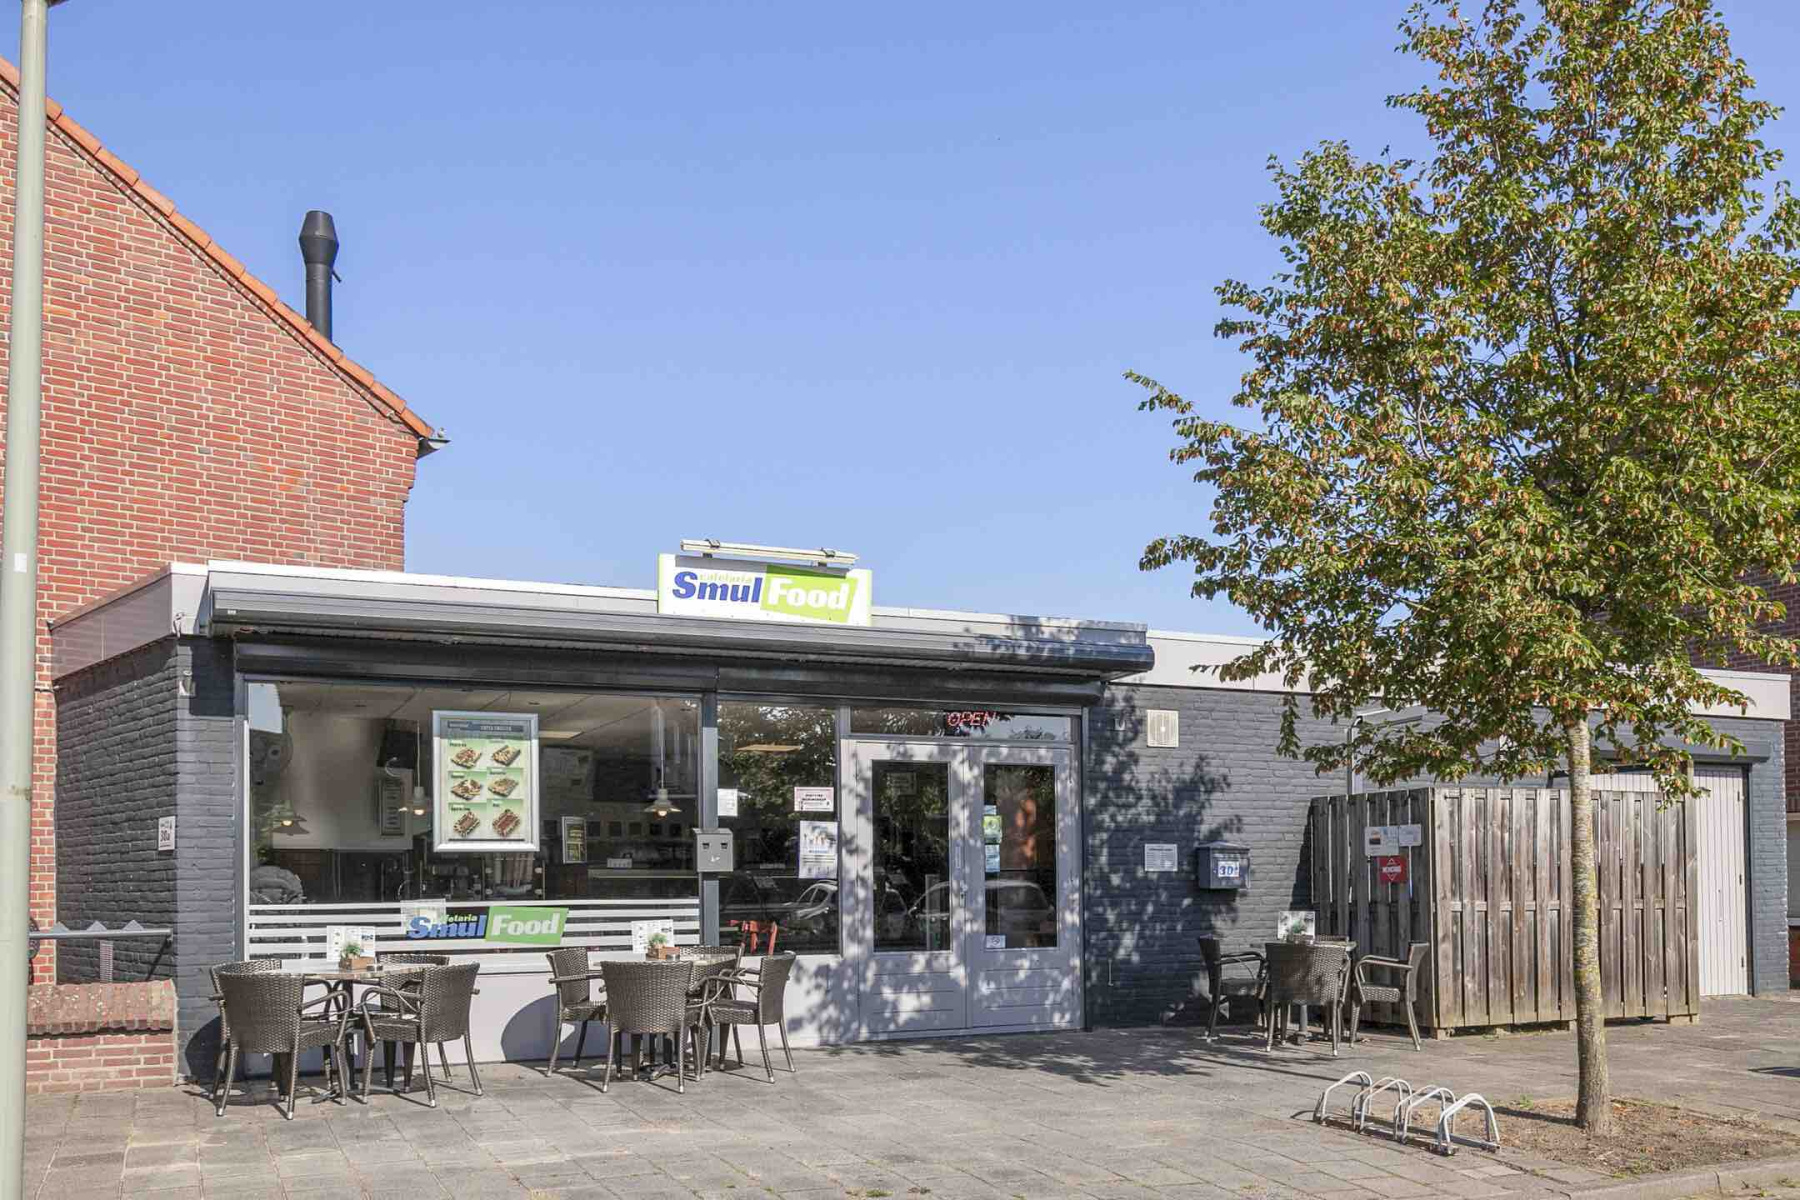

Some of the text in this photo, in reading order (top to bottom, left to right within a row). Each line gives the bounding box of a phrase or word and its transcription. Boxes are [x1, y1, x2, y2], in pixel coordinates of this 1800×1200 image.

[672, 571, 850, 610] Smul Food
[948, 711, 996, 726] OPEN
[406, 912, 561, 939] Smul Food
